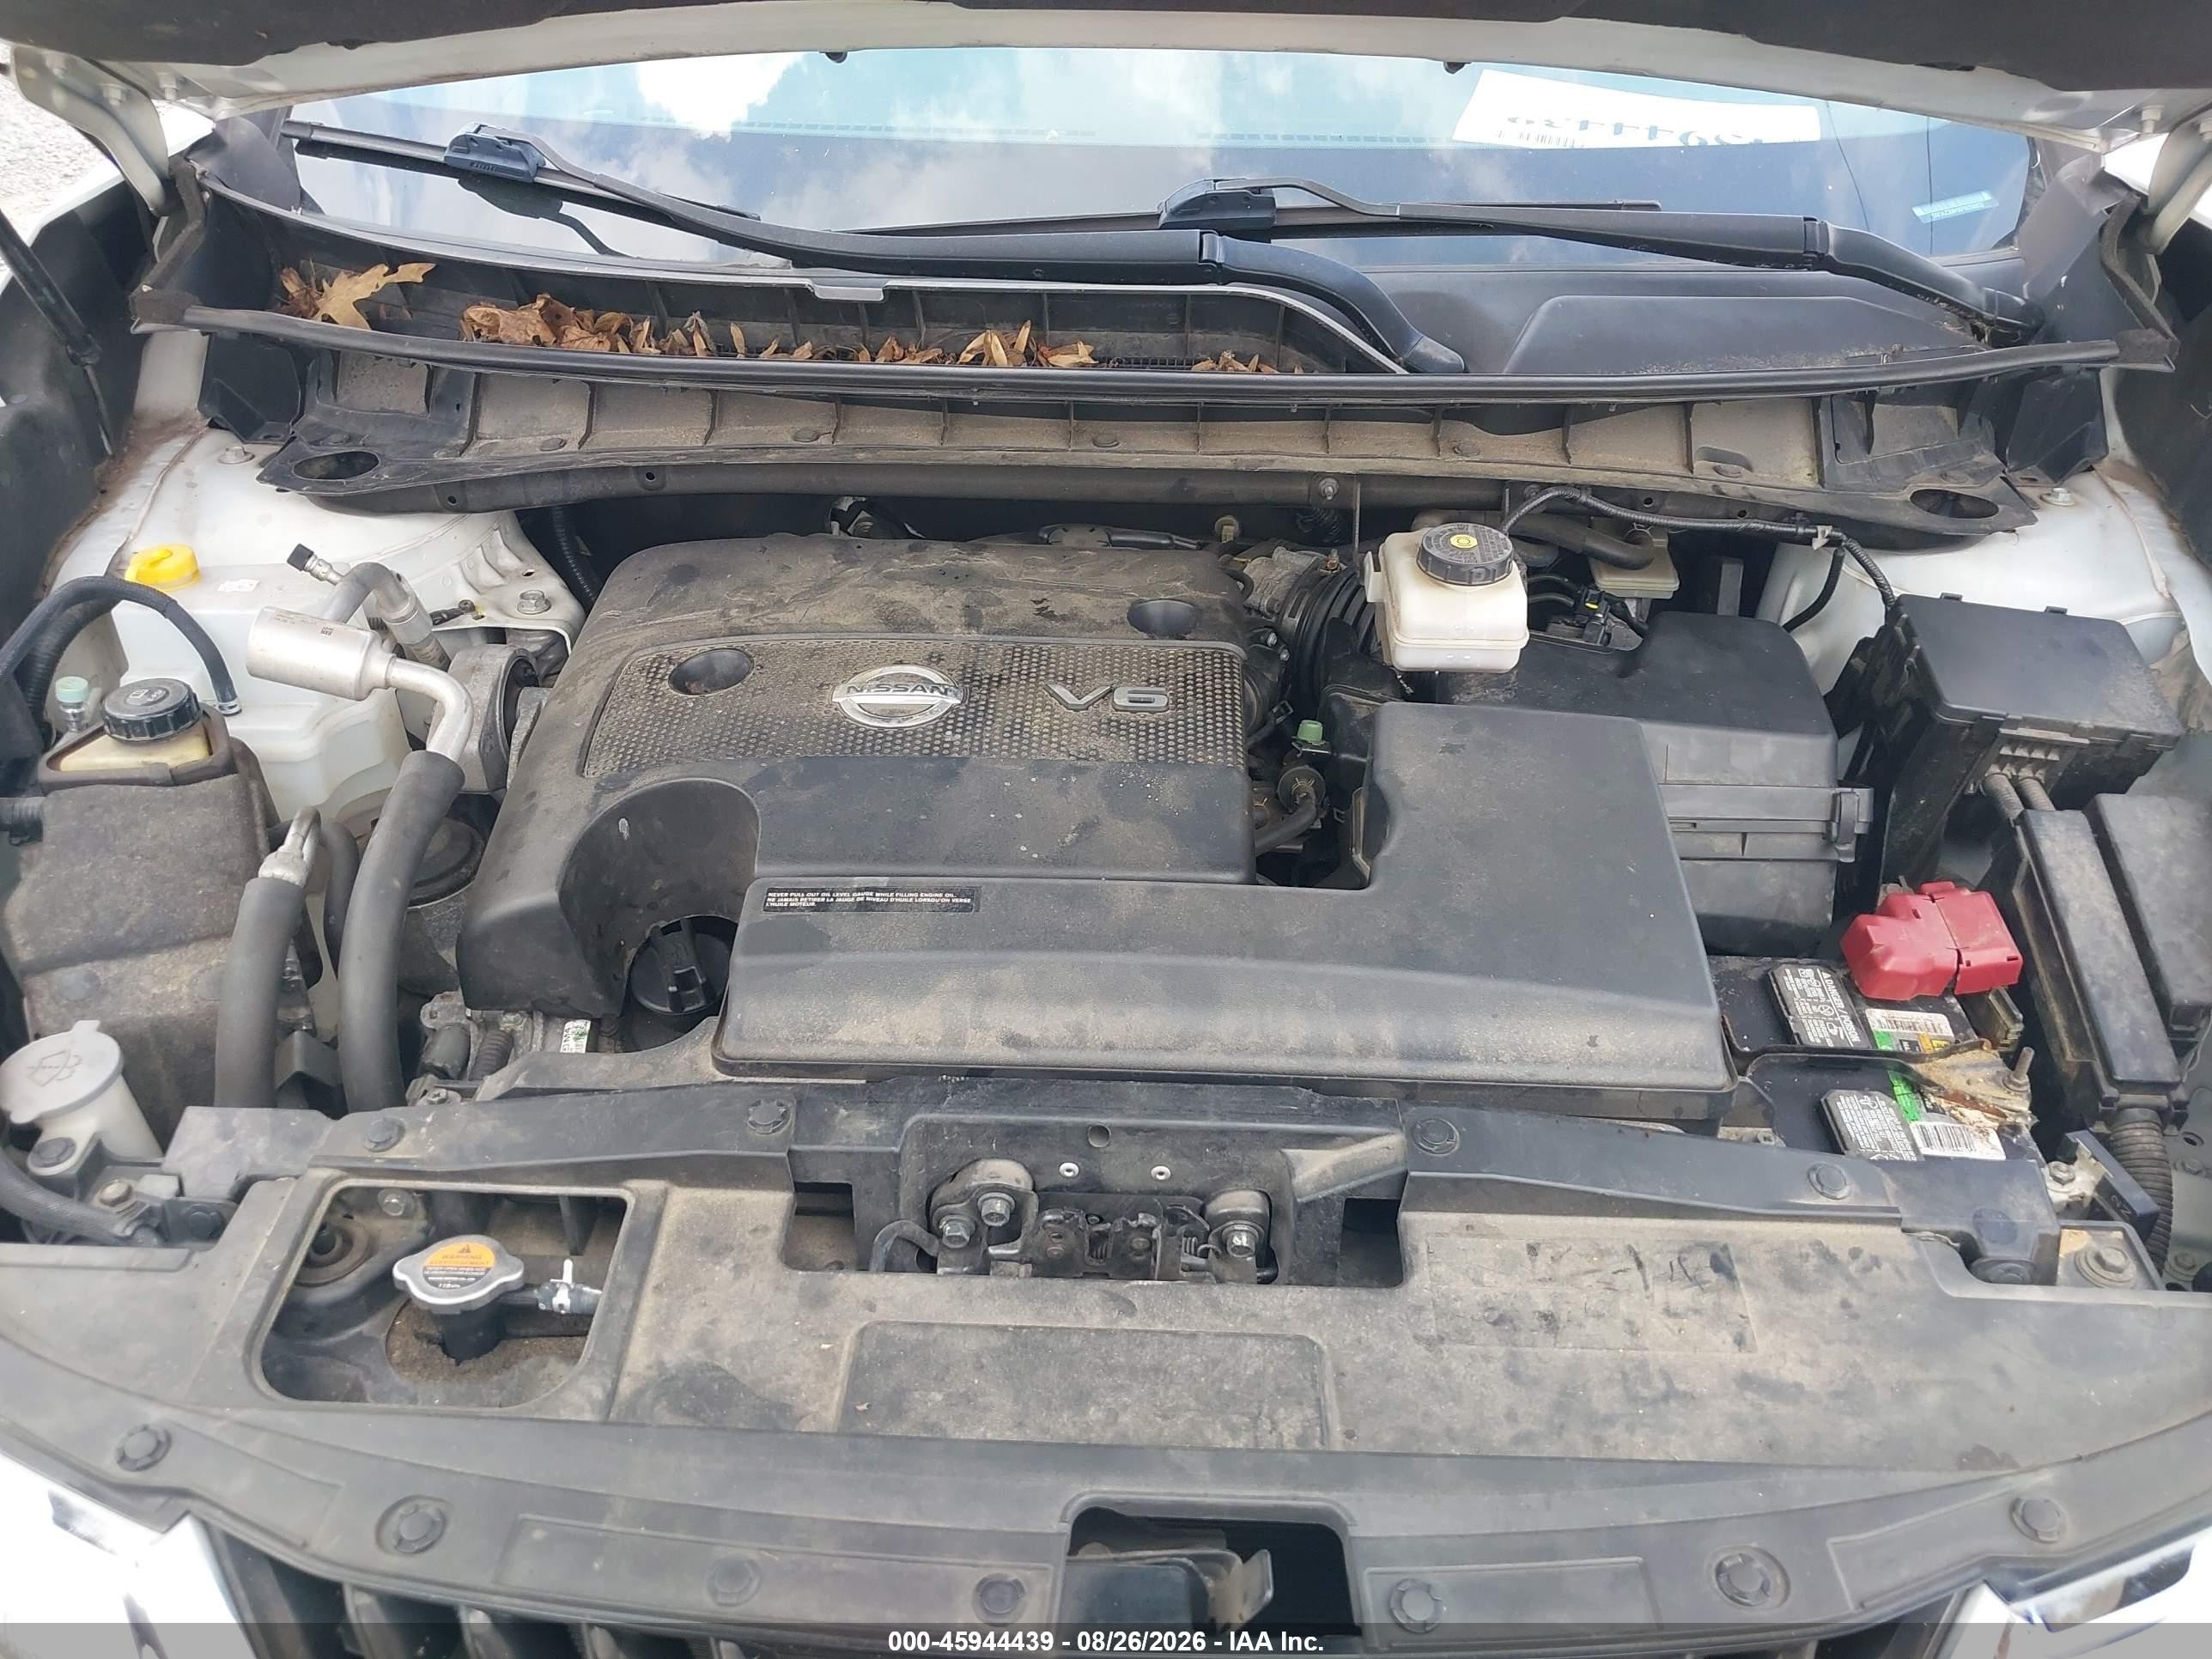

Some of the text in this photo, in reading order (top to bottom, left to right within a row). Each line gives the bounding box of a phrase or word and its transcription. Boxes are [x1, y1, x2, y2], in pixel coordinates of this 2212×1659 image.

[847, 684, 949, 696] NISSAN
[1043, 684, 1169, 713] V6
[1825, 979, 1845, 1009] DANGER
[1840, 1015, 1862, 1042] POISON
